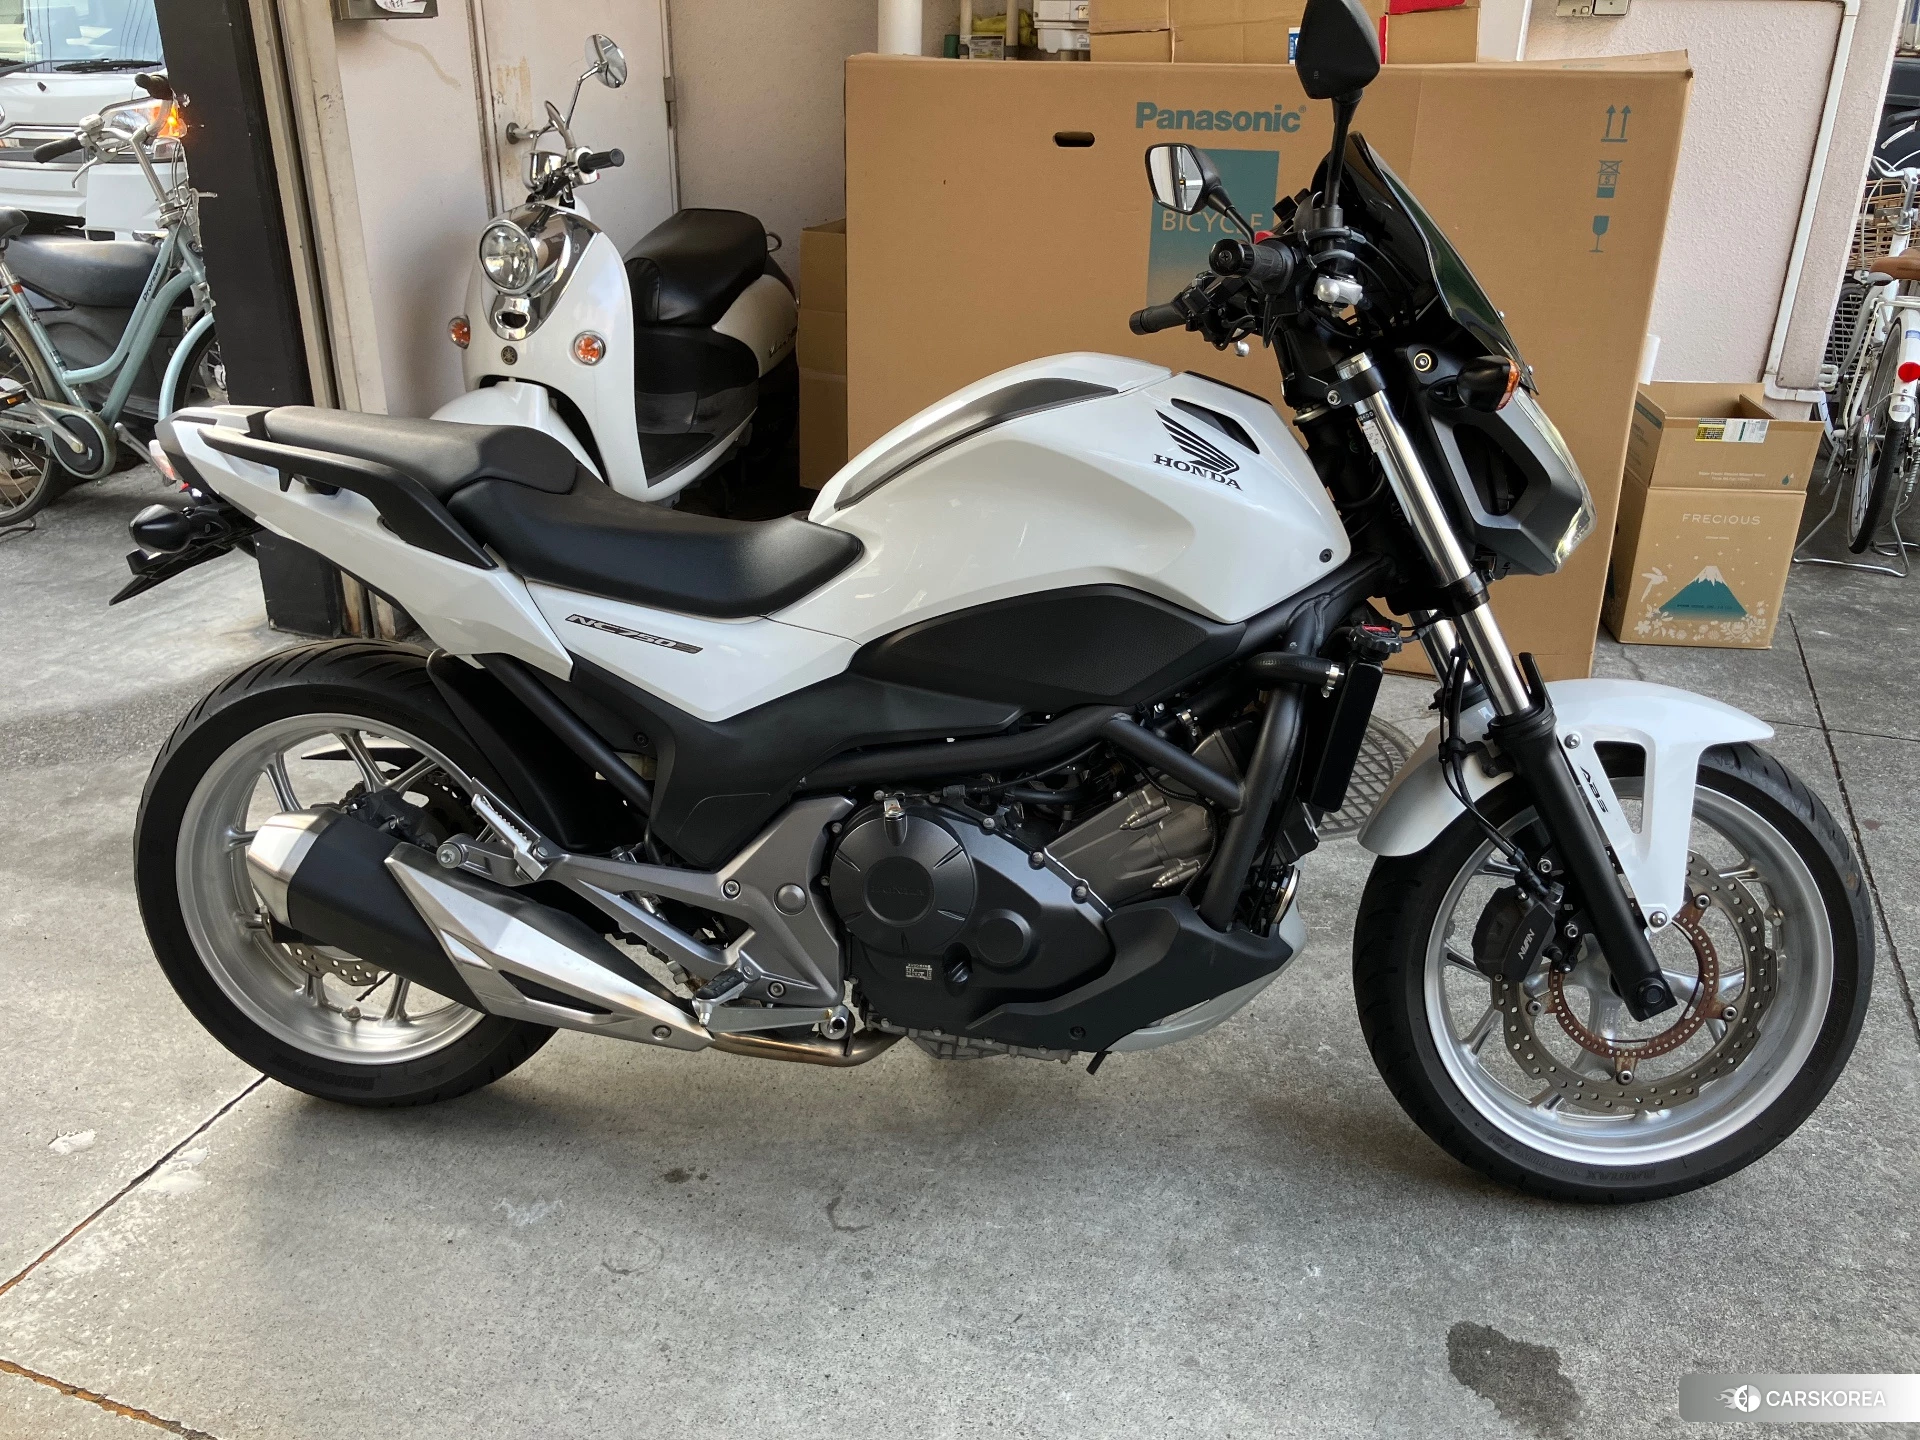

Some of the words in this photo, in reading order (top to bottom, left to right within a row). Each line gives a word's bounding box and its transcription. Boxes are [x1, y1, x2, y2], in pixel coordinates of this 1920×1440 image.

[1135, 101, 1301, 133] Panasonic
[1161, 210, 1264, 234] BICYCE
[1153, 453, 1244, 491] HONDA
[1682, 513, 1761, 525] FRECIOUS
[1580, 766, 1608, 812] ABS
